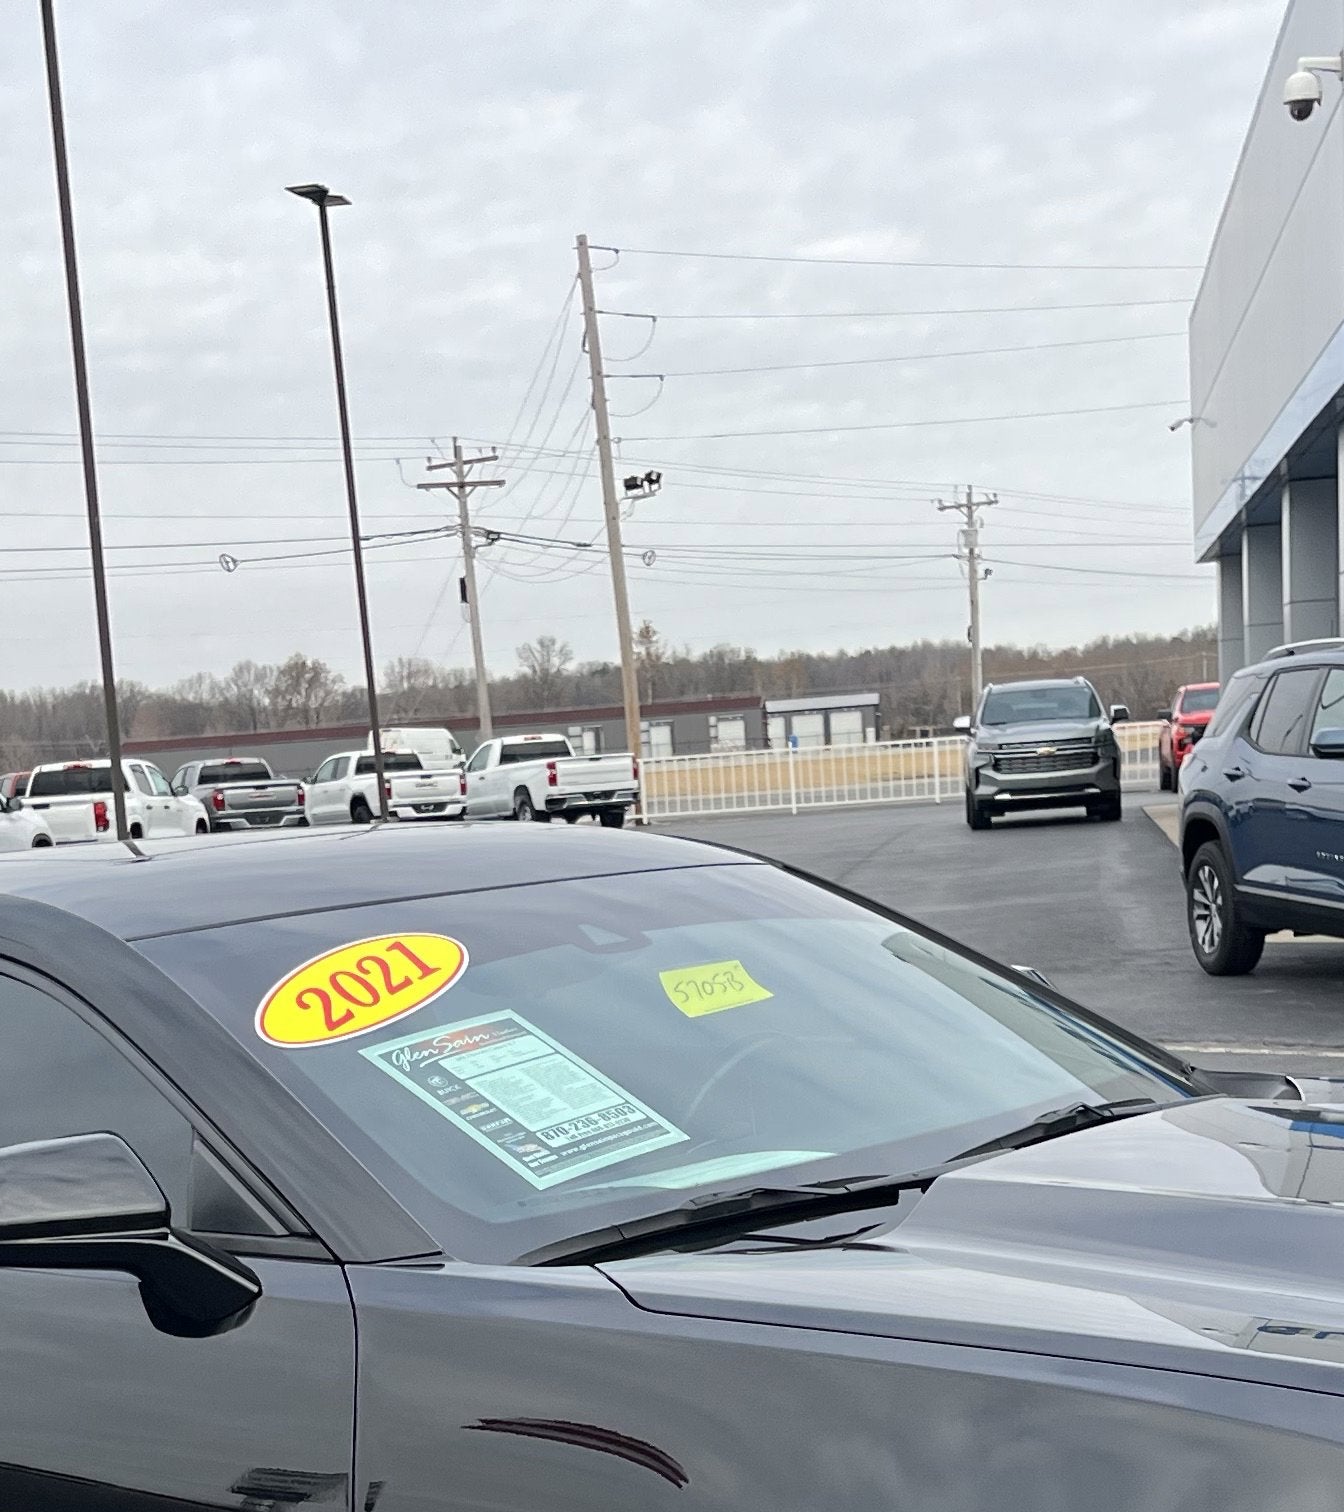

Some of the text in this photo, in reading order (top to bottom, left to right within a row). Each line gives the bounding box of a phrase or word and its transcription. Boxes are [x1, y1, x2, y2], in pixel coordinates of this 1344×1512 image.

[295, 941, 442, 1031] 2021
[391, 1043, 438, 1071] Glen
[432, 1030, 491, 1056] Sain
